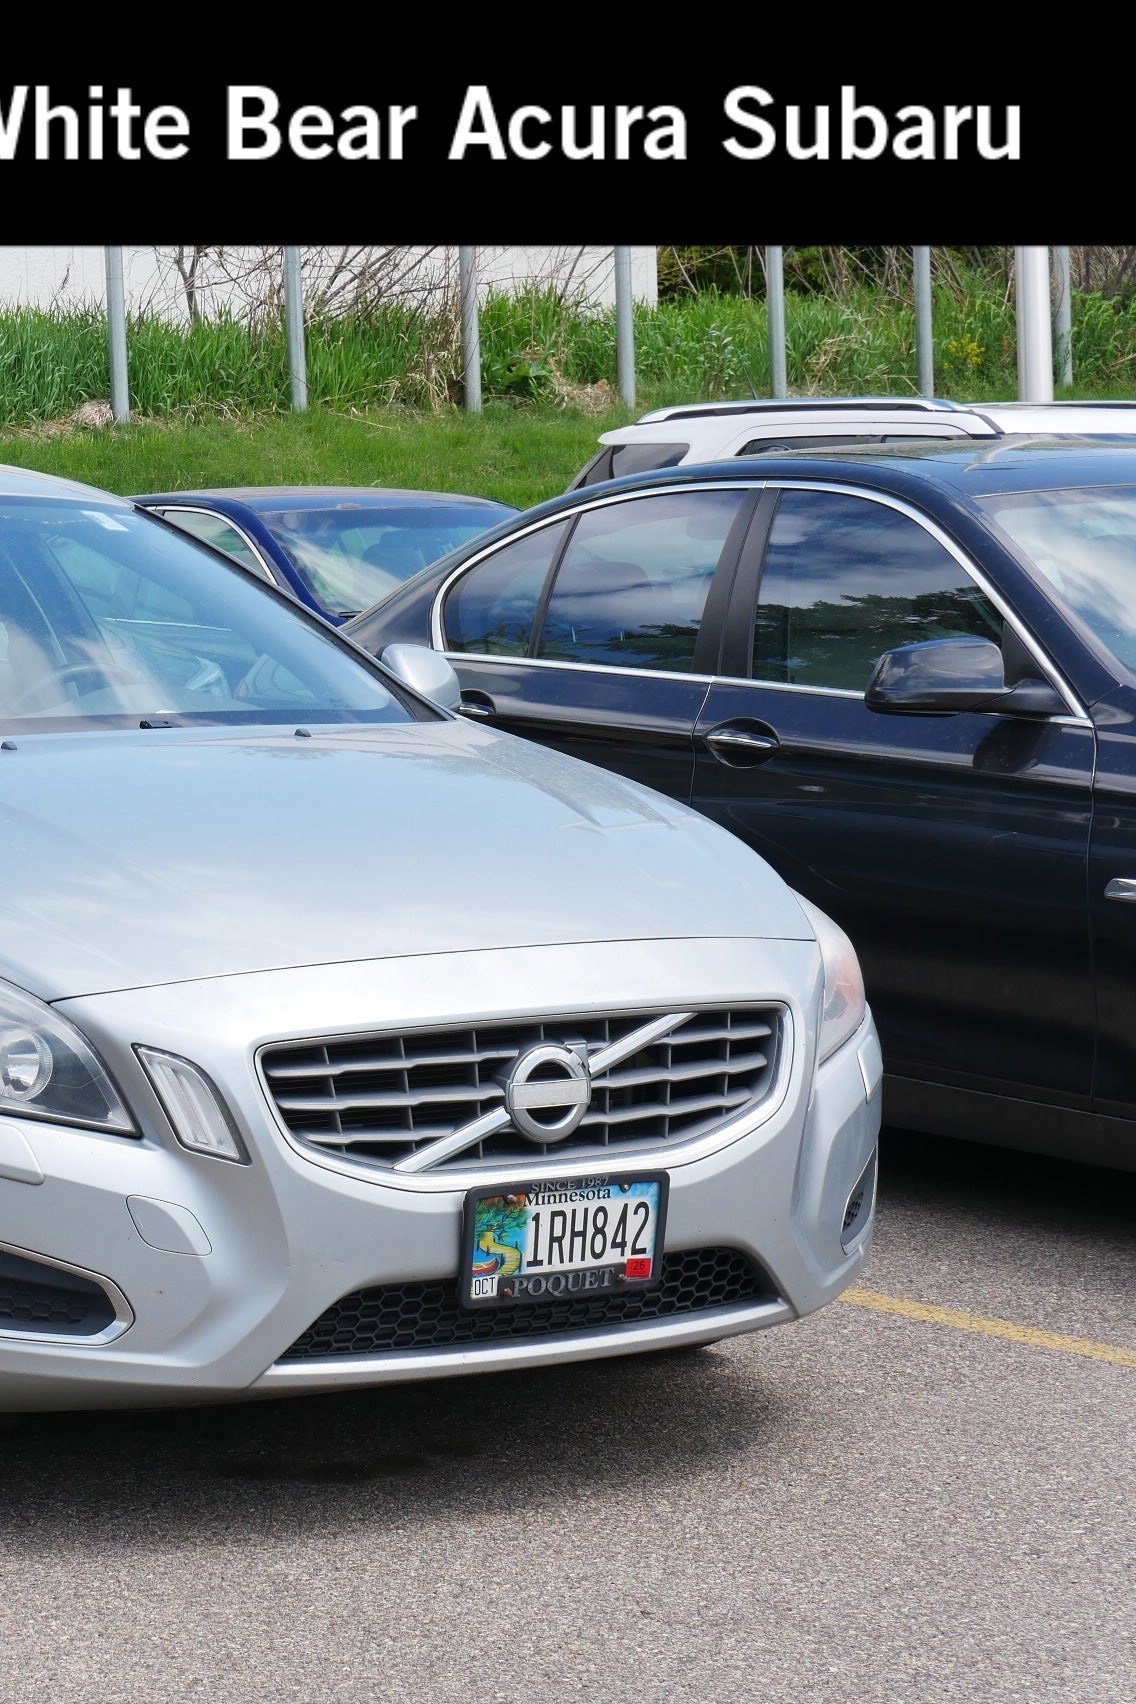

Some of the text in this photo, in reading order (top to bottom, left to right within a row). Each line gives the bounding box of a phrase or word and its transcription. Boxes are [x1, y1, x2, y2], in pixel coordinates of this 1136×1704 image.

[531, 1175, 610, 1193] SINCE 1987
[523, 1187, 611, 1207] Minnesota
[526, 1201, 650, 1268] 1RH842
[633, 1260, 645, 1271] 26
[474, 1276, 496, 1296] OCT
[512, 1267, 615, 1298] POQUET
